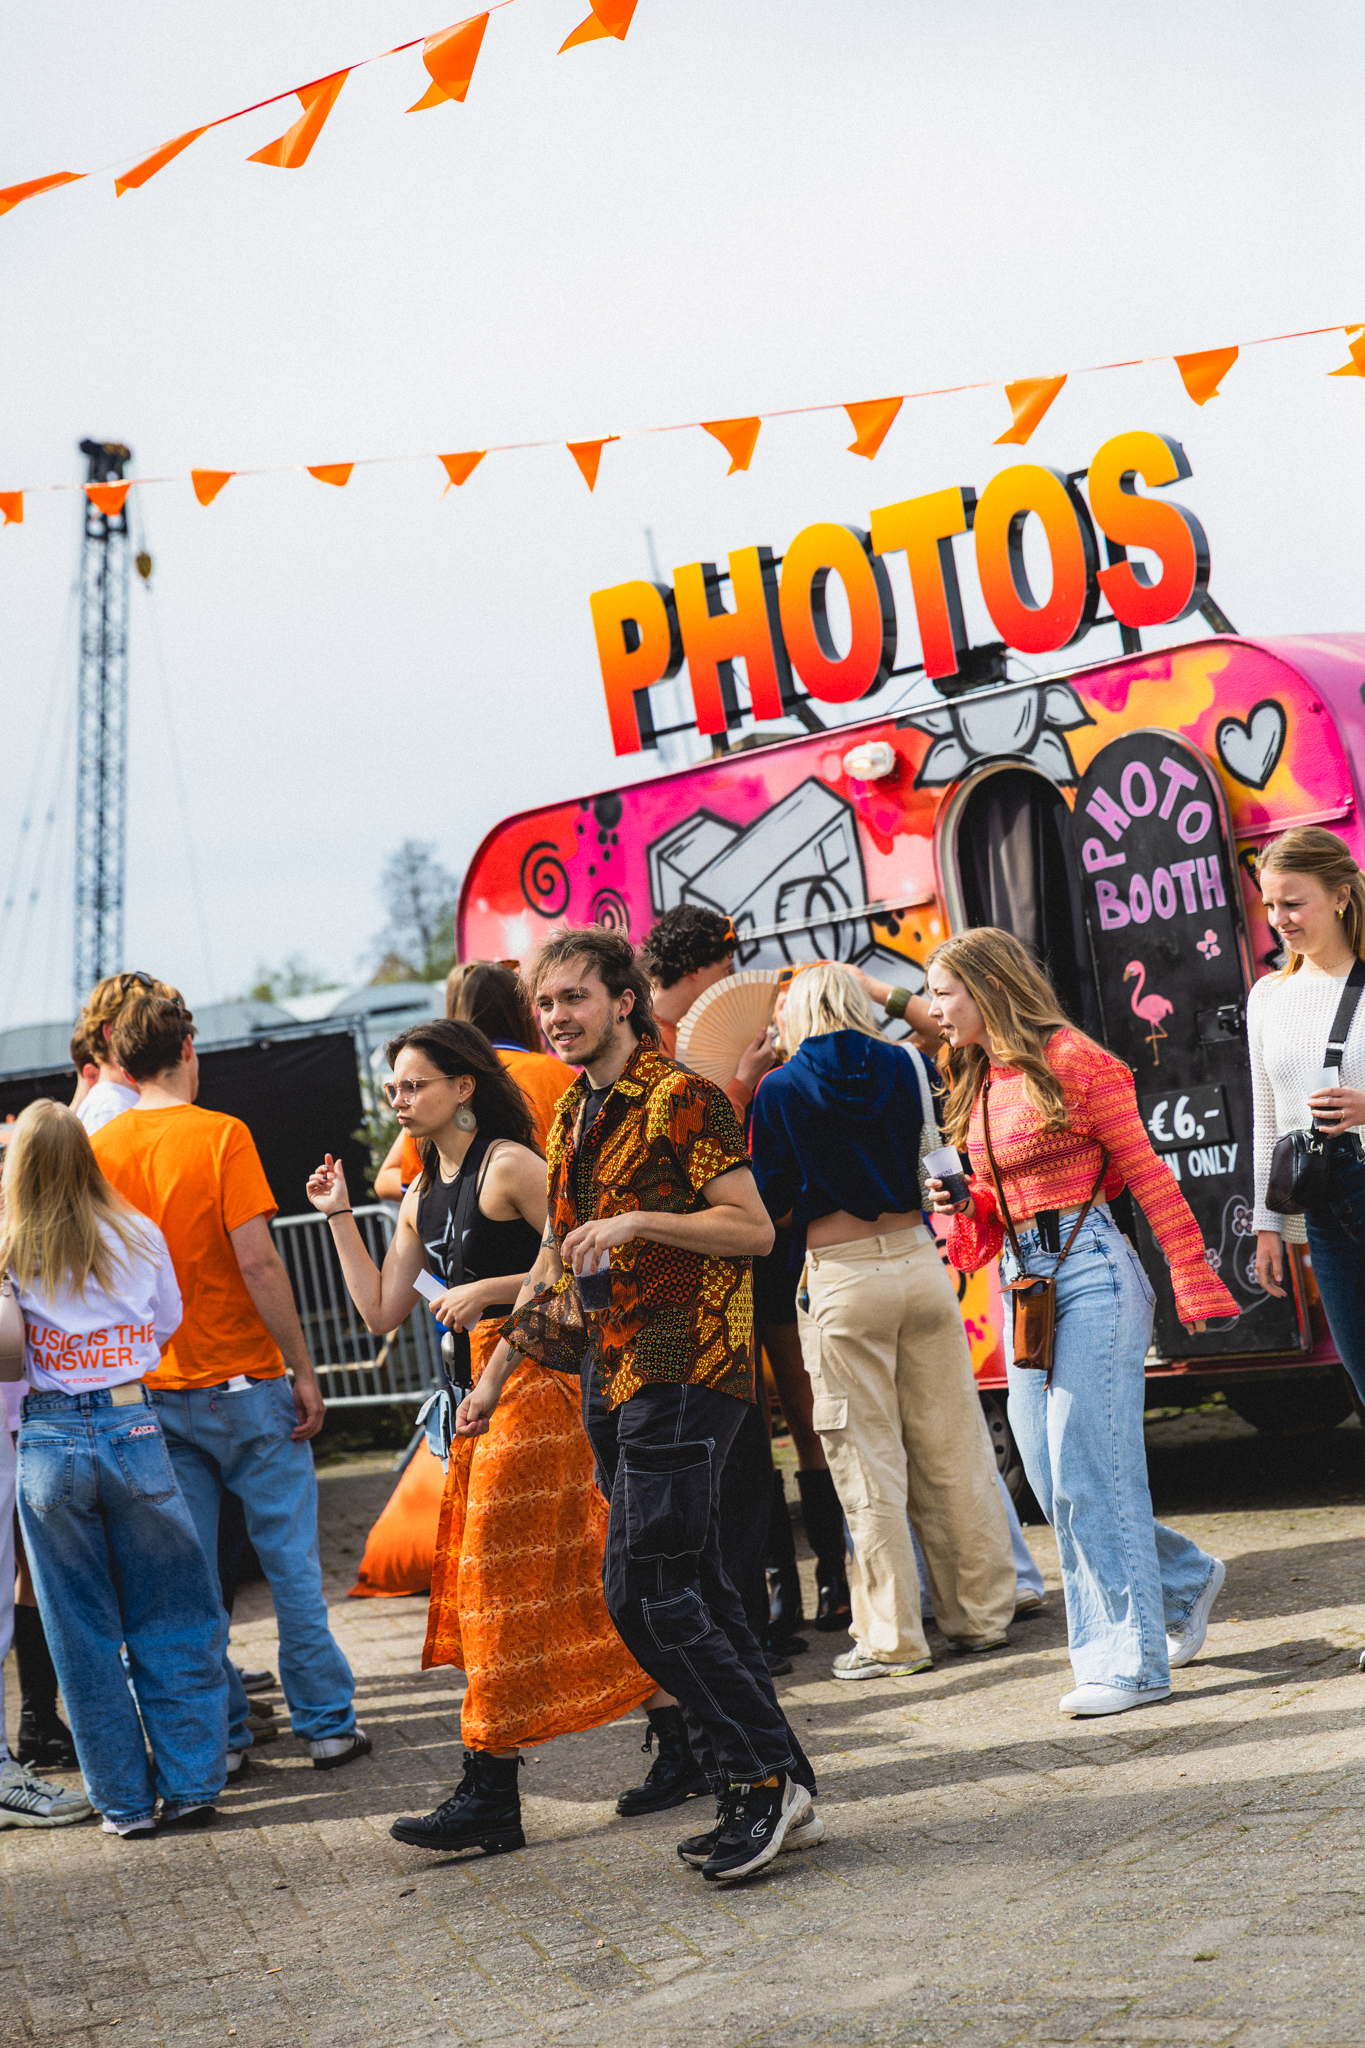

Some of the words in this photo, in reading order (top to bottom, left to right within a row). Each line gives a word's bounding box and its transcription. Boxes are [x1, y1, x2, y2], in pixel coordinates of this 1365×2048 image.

[589, 430, 1205, 756] PHOTOS
[1082, 756, 1212, 874] PHOTO
[1095, 855, 1226, 931] BOOTH
[1148, 1095, 1220, 1142] €6,-
[1187, 1142, 1239, 1178] ONLY
[33, 1346, 140, 1371] ANSWER.
[87, 1328, 109, 1347] IS
